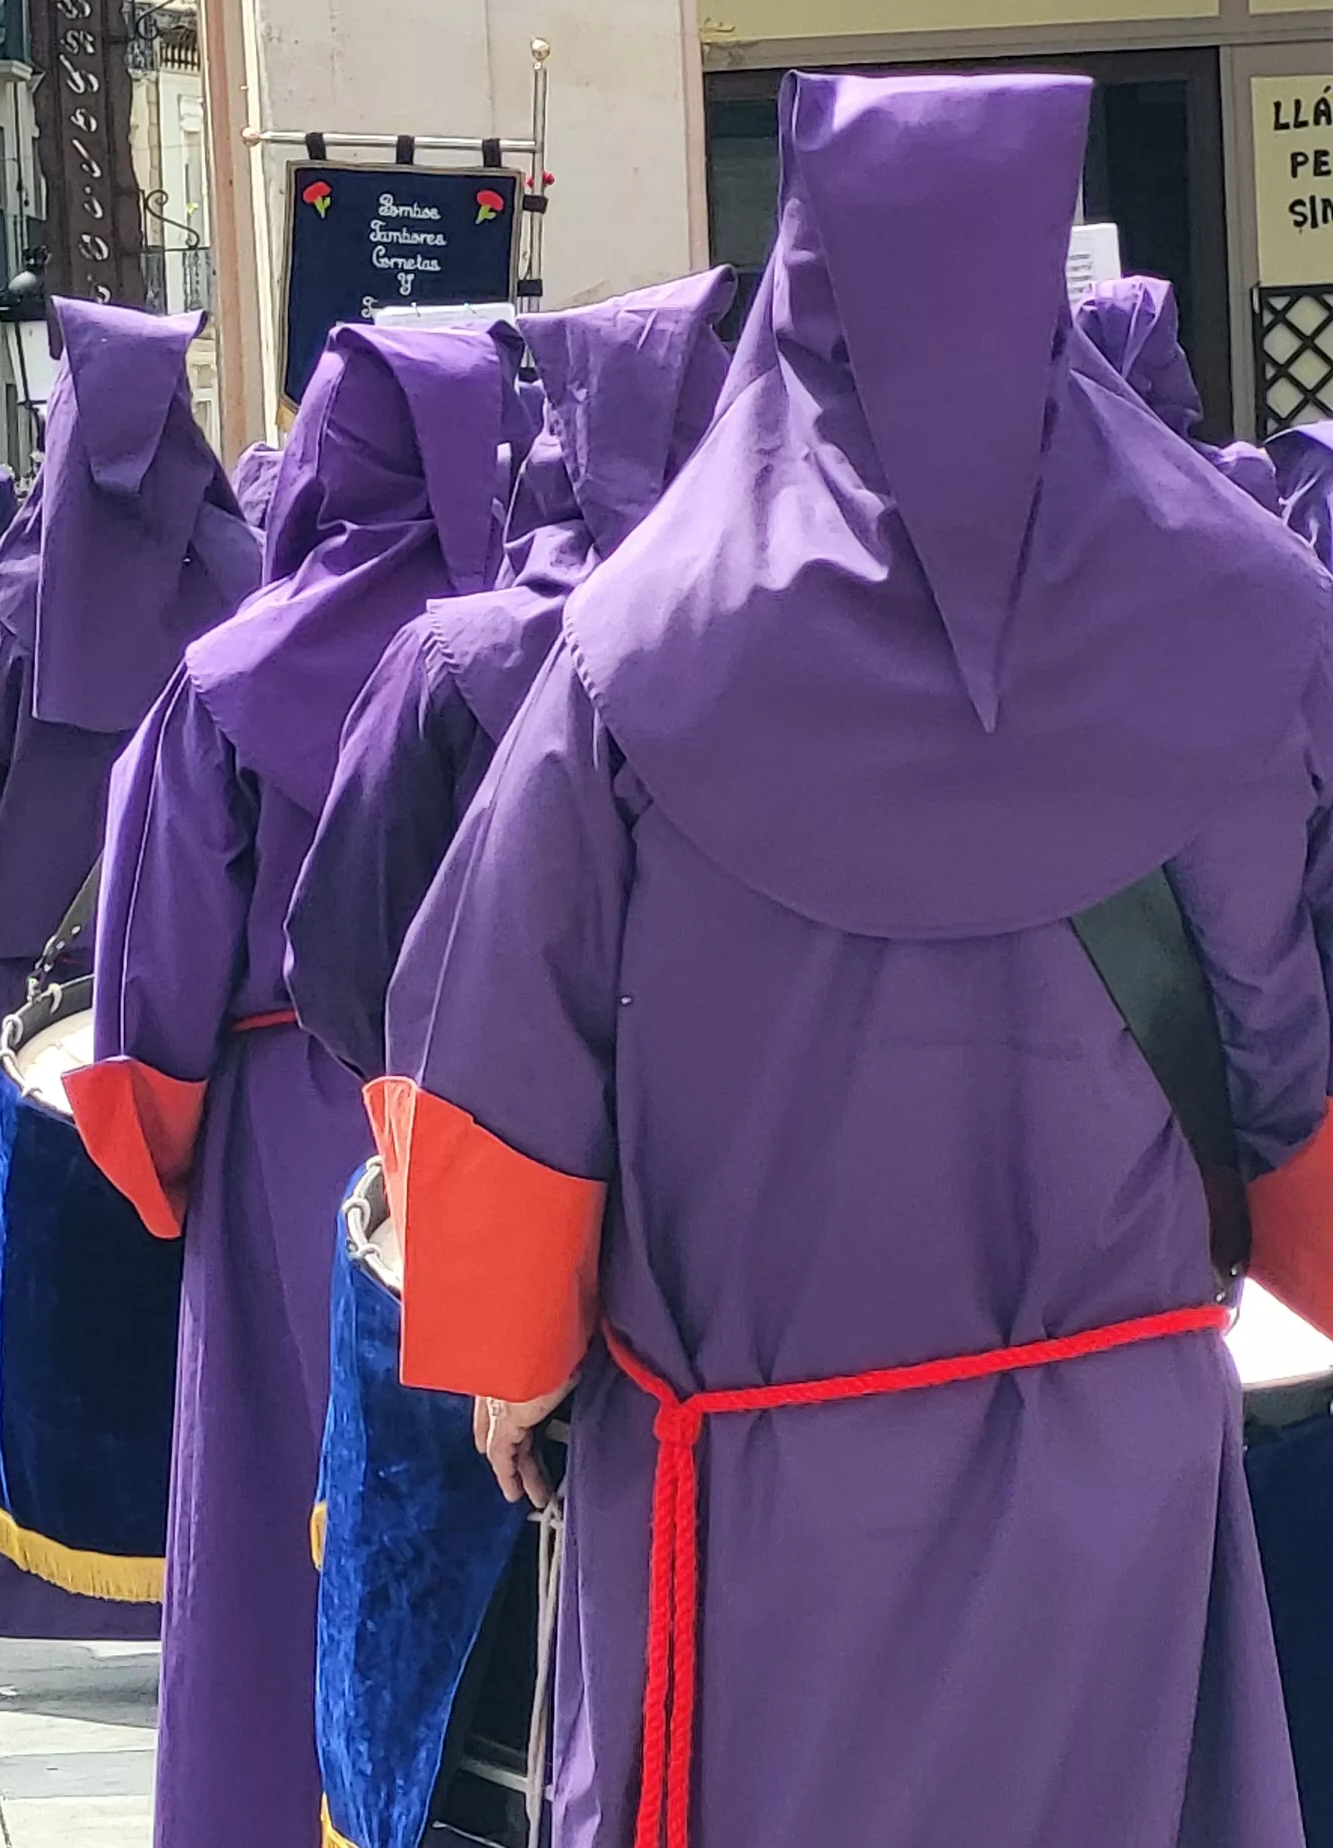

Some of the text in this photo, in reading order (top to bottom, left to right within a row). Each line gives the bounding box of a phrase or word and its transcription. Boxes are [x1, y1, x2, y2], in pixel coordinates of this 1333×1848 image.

[1290, 150, 1333, 179] PE
[369, 219, 447, 246] Tambores
[371, 245, 441, 271] Cornetas
